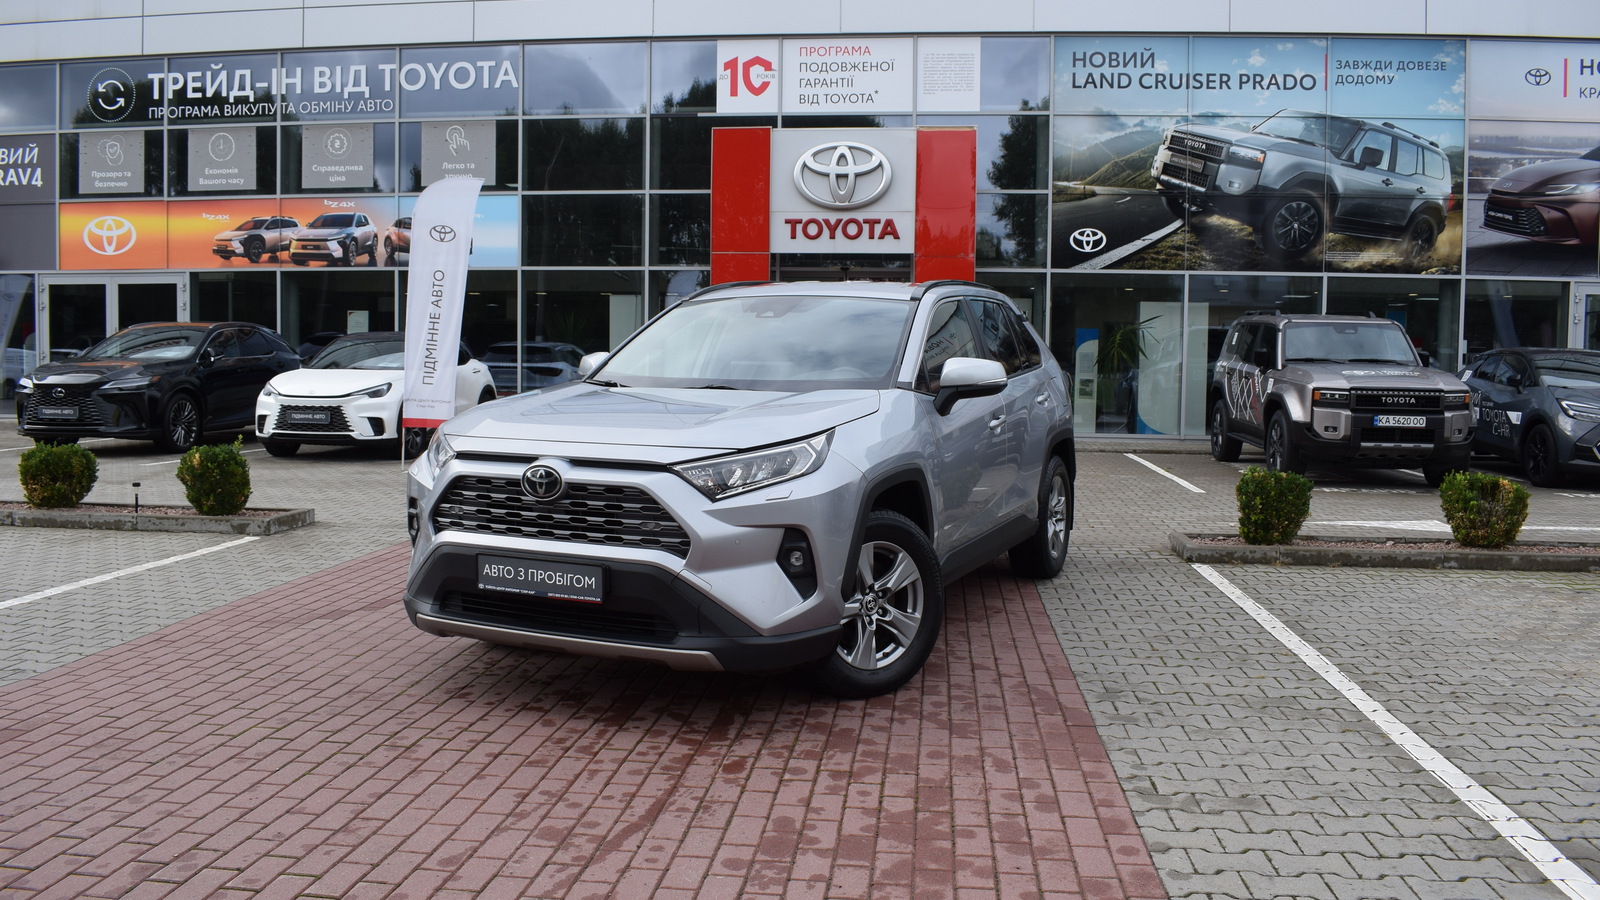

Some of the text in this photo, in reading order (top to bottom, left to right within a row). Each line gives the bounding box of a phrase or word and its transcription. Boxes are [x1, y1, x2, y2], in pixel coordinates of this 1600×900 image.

[799, 46, 871, 57] ПРОГРАМА
[1072, 47, 1155, 69] НОВИЙ
[799, 59, 895, 74] ПОДОВЖЕНОЇ
[1335, 60, 1447, 73] ЗАВЖДИ ДОВЕЗЕ
[148, 60, 519, 103] ТРЕЙД-ІН ВІД TOYOTA
[799, 75, 855, 89] ГАРАНТІЇ
[1072, 72, 1317, 91] LAND CRUISER PRADO
[1335, 74, 1395, 86] ДОДОМУ
[799, 94, 820, 106] ВІД
[149, 99, 394, 119] ПРОГРАМА ВИКУПУ ТА ОБМІНУ АВТО
[1184, 140, 1206, 149] TOYOTA
[205, 167, 239, 175] Економія
[312, 164, 364, 174] Справедлива
[442, 162, 465, 170] Легко
[91, 170, 123, 179] Прозоро
[329, 174, 346, 183] ціна
[94, 180, 128, 188] безпечно
[199, 177, 245, 186] Вашого часу
[784, 218, 900, 240] TOYOTA
[422, 269, 445, 385] ПІДМІННЕ АВТО
[1381, 396, 1416, 404] TOYOTA
[1392, 416, 1411, 426] 5620
[1482, 407, 1507, 424] TOYOTA
[1492, 422, 1511, 438] C-HR
[483, 564, 515, 579] АВТО
[528, 568, 596, 590] ПРОБІГОМ
